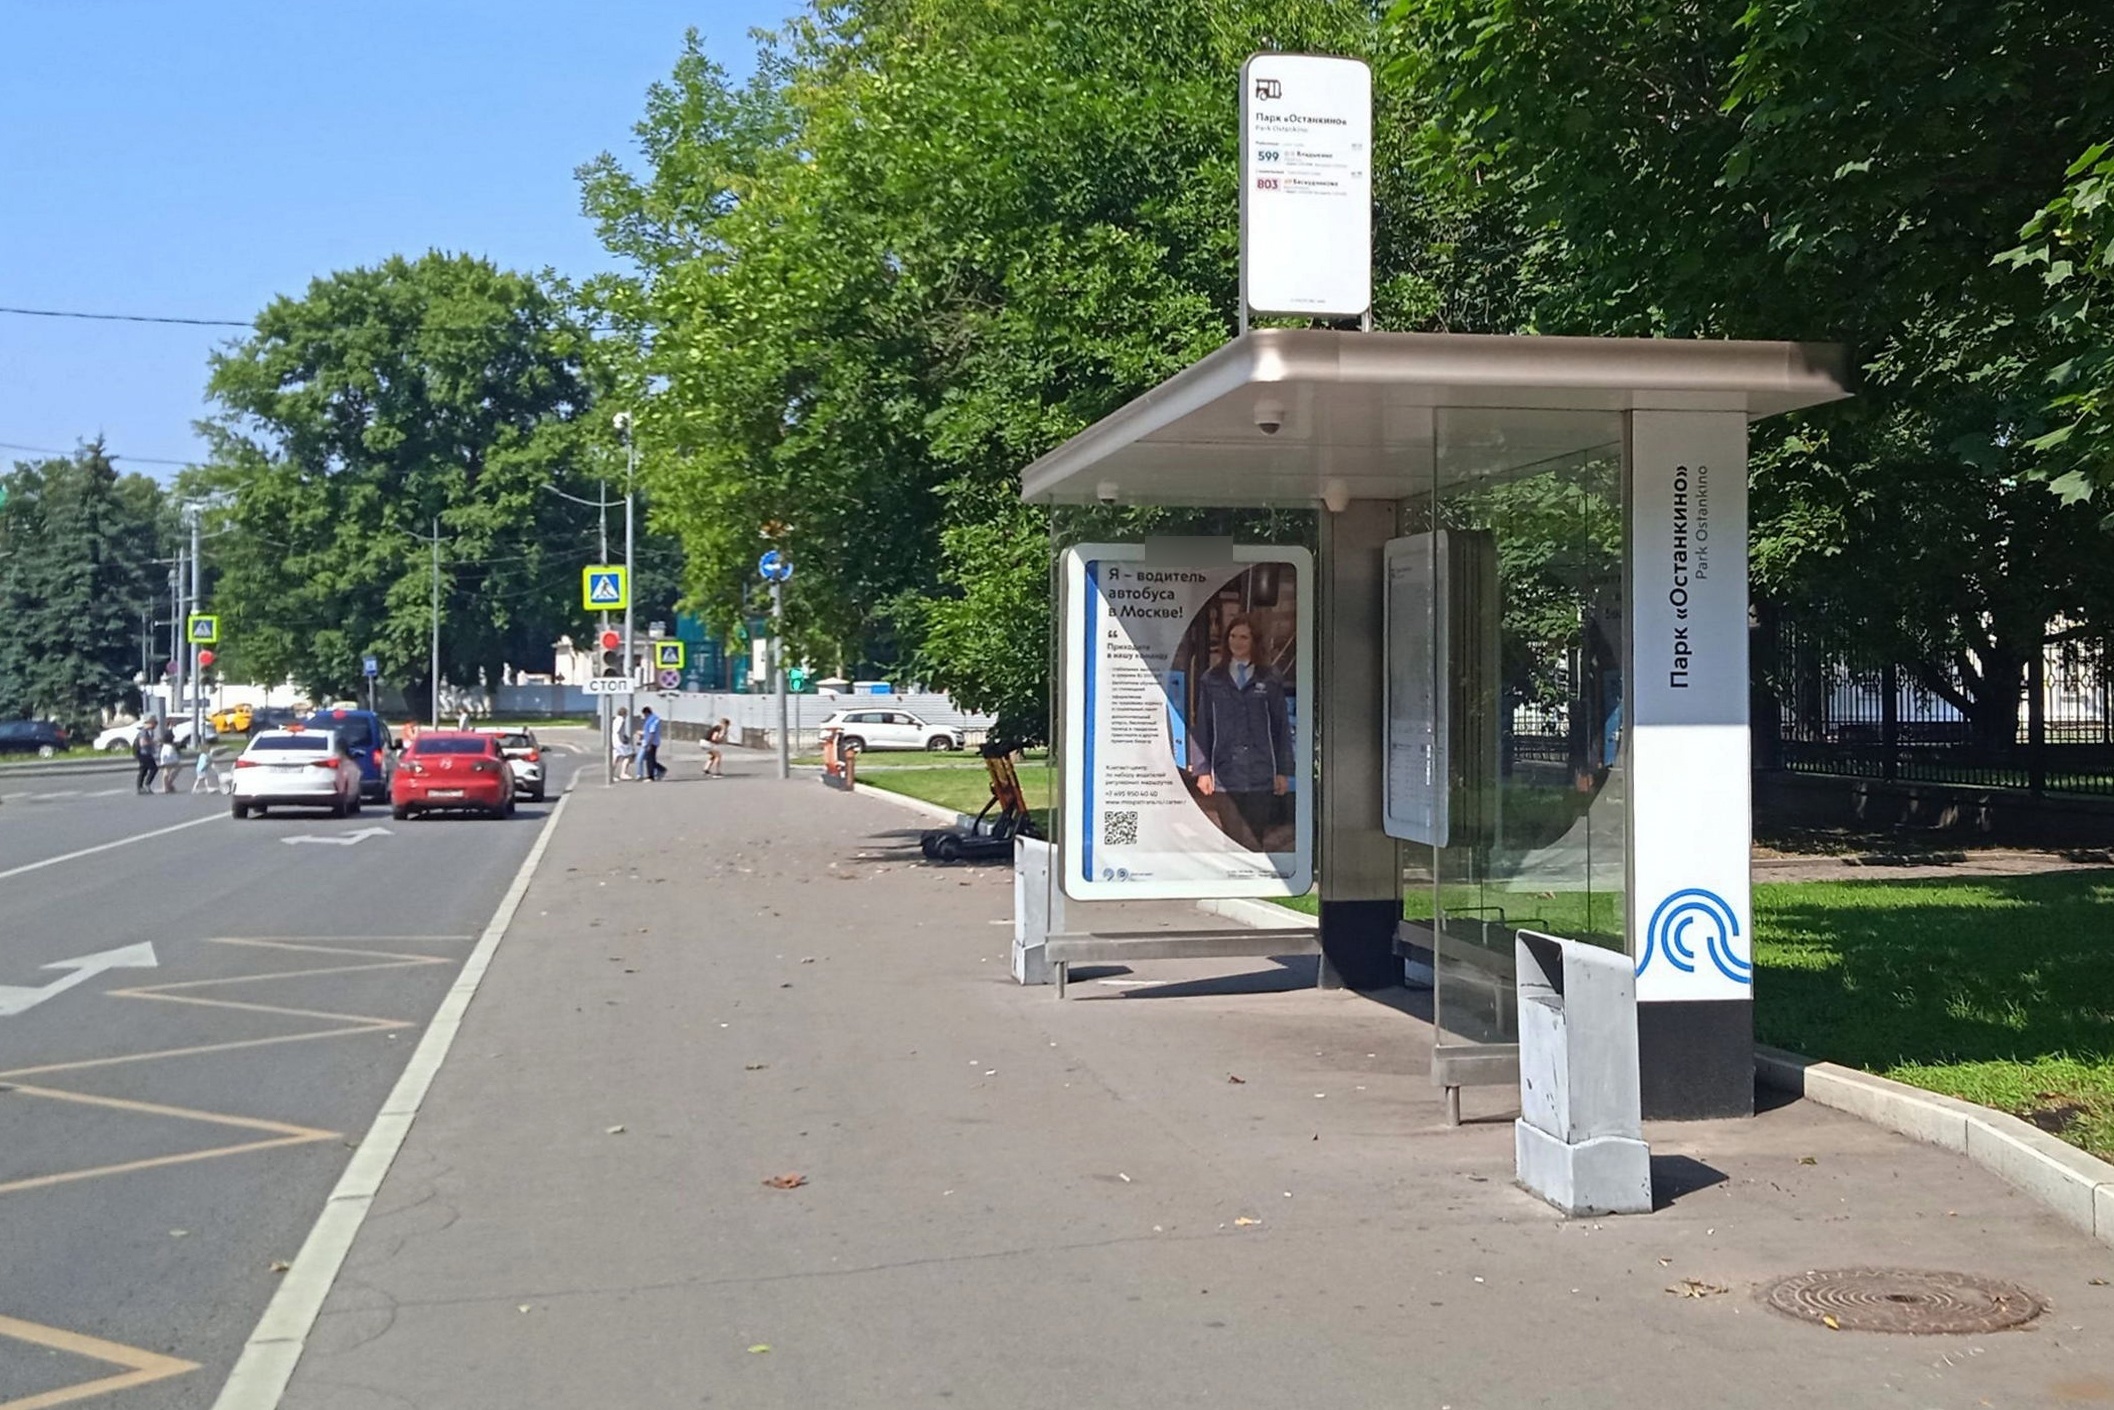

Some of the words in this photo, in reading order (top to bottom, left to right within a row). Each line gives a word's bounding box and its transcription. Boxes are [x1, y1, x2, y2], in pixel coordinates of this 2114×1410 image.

[1256, 112, 1281, 123] Парк
[1284, 114, 1347, 126] «Останкино»
[1258, 151, 1279, 161] 599
[1257, 179, 1278, 190] 803
[1695, 465, 1708, 541] Ostankino
[1669, 465, 1688, 619] «Останкино»
[1695, 546, 1708, 580] Park
[1109, 568, 1119, 580] Я
[1137, 572, 1207, 583] водитель
[1108, 587, 1175, 602] автобуса
[1108, 607, 1117, 617] в
[1120, 605, 1183, 618] Москве!
[1107, 643, 1150, 651] Приходите
[1670, 627, 1692, 688] Парк
[589, 680, 627, 691] СТОП
